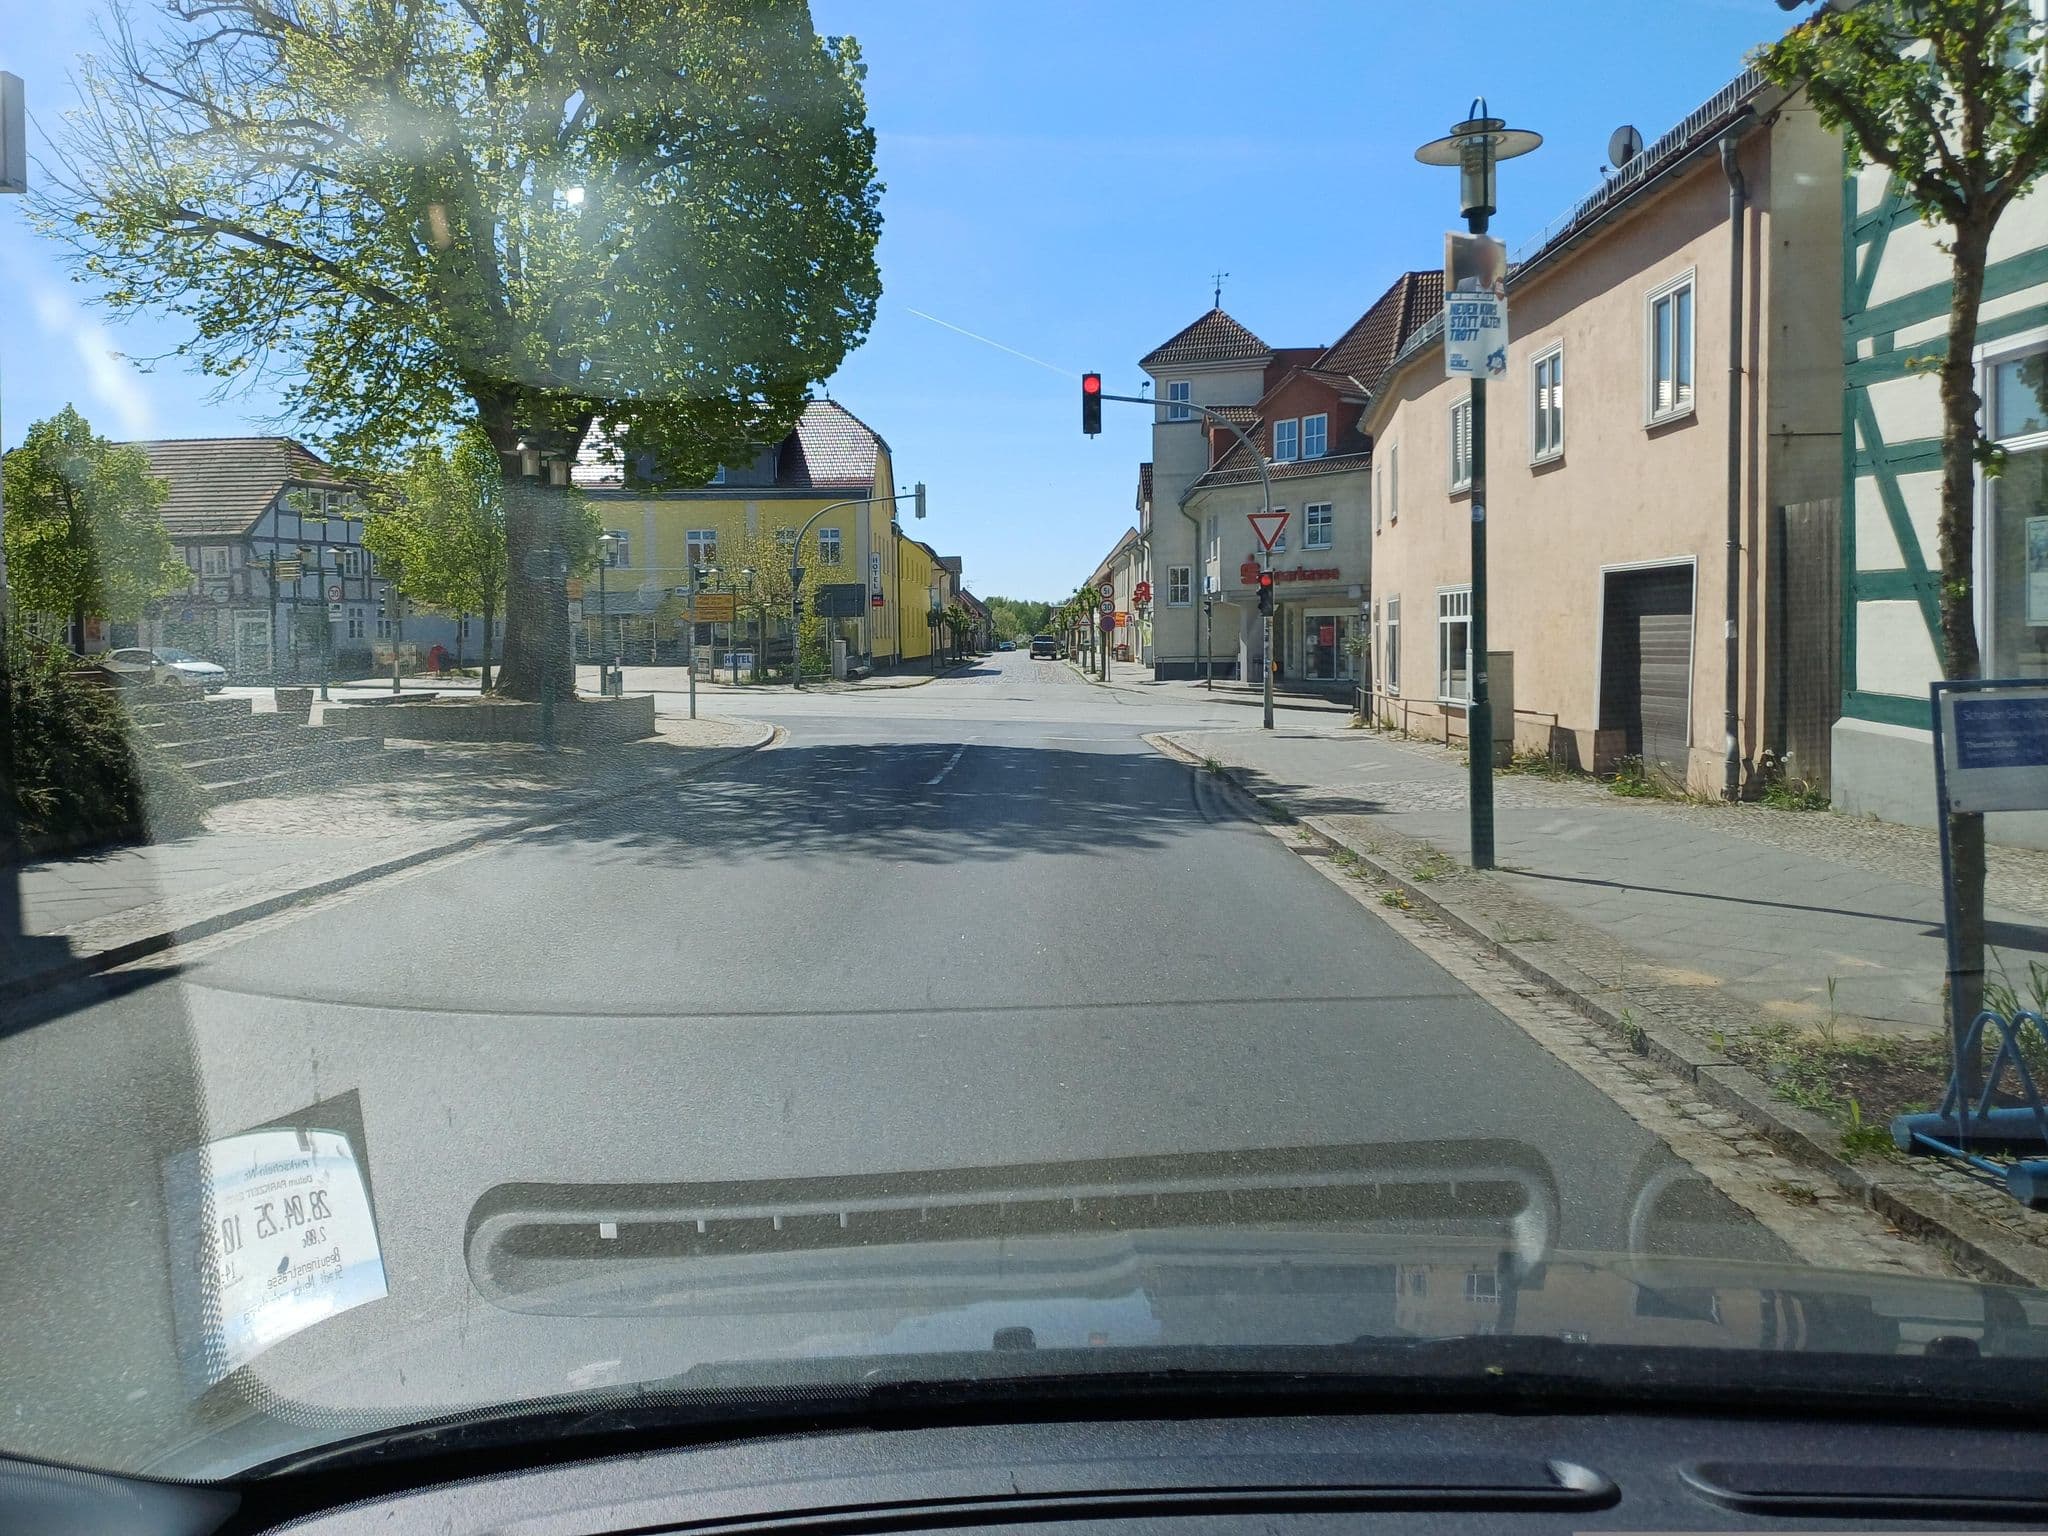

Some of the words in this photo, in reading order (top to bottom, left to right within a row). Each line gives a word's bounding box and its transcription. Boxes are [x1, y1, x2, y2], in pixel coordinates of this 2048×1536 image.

[1450, 303, 1478, 315] NEUER
[1450, 316, 1479, 328] STATT
[1450, 329, 1479, 341] TROTT
[331, 589, 339, 598] 30
[1103, 603, 1112, 611] 30
[724, 655, 752, 664] HOTEL
